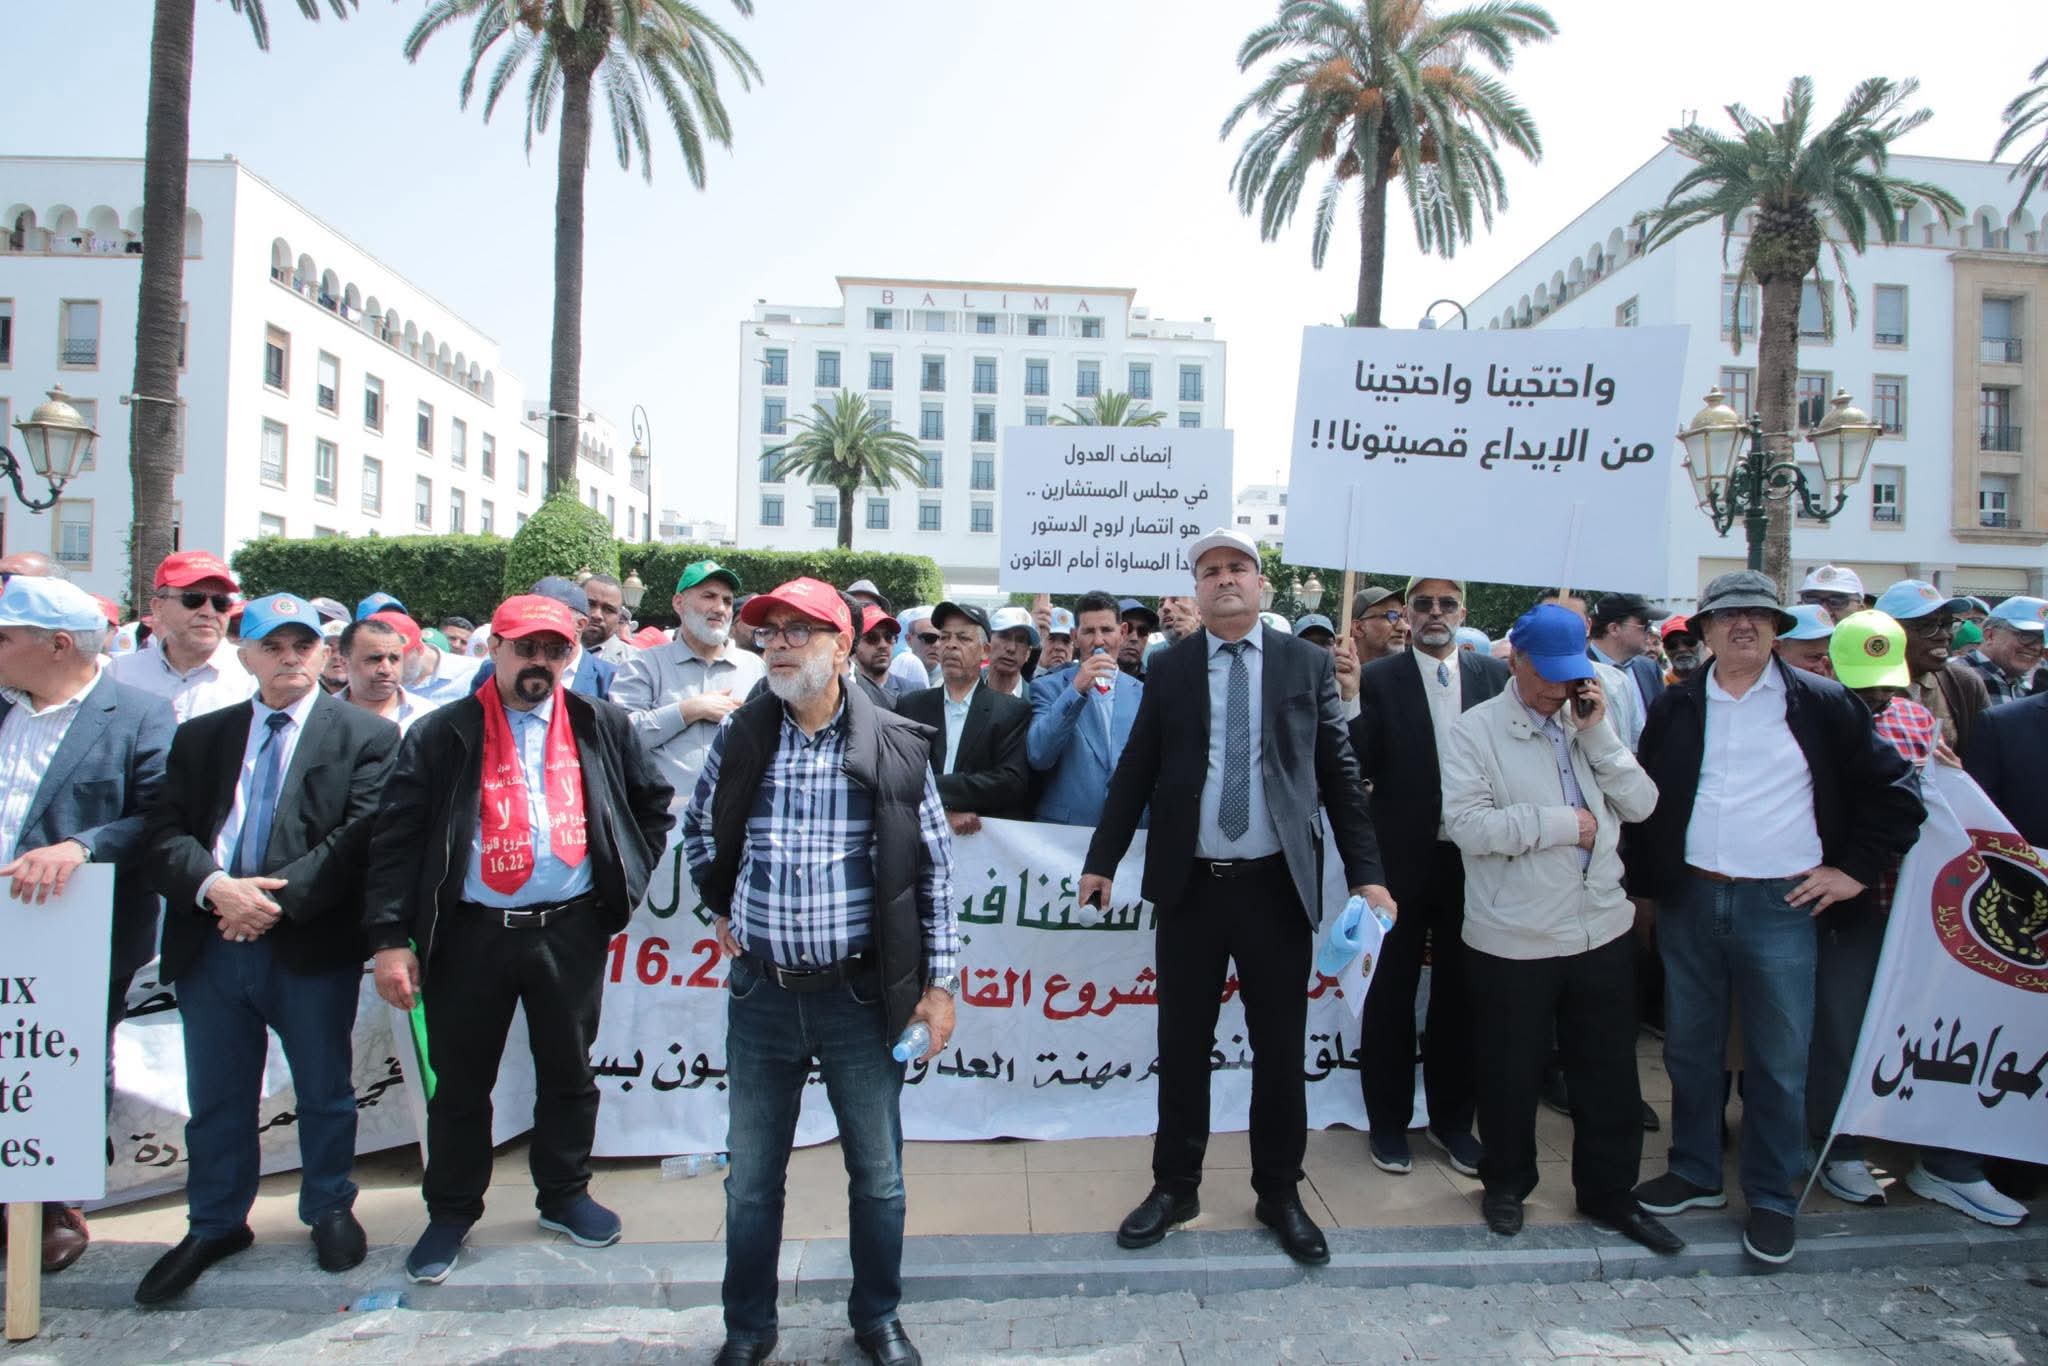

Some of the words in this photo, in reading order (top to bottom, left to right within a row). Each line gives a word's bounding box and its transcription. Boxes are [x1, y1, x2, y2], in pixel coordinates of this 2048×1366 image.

[881, 289, 1090, 313] BALIMA
[1310, 418, 1468, 464] قصيتونا!!
[1479, 426, 1590, 473] الإيداع
[1064, 443, 1115, 466] العدول
[1120, 445, 1172, 470] إنصاف
[1600, 436, 1656, 471] من
[1041, 479, 1128, 501] المستشارين
[1132, 481, 1179, 504] مجلس
[1184, 484, 1209, 511] في
[1031, 515, 1087, 536] الدستور
[1092, 515, 1124, 539] لروح
[1128, 517, 1173, 538] انتصار
[1179, 521, 1201, 539] هو
[1010, 549, 1062, 571] القانون
[1066, 544, 1100, 573] أمام
[1104, 551, 1170, 573] المساواة
[1175, 547, 1191, 571] دأ
[561, 774, 575, 806] لا
[497, 797, 510, 831] لا
[490, 854, 524, 873] 16.22
[608, 933, 729, 988] 16.2
[960, 965, 1031, 1007] القا
[1042, 966, 1158, 1020] شروع
[1033, 1050, 1133, 1090] مهنة
